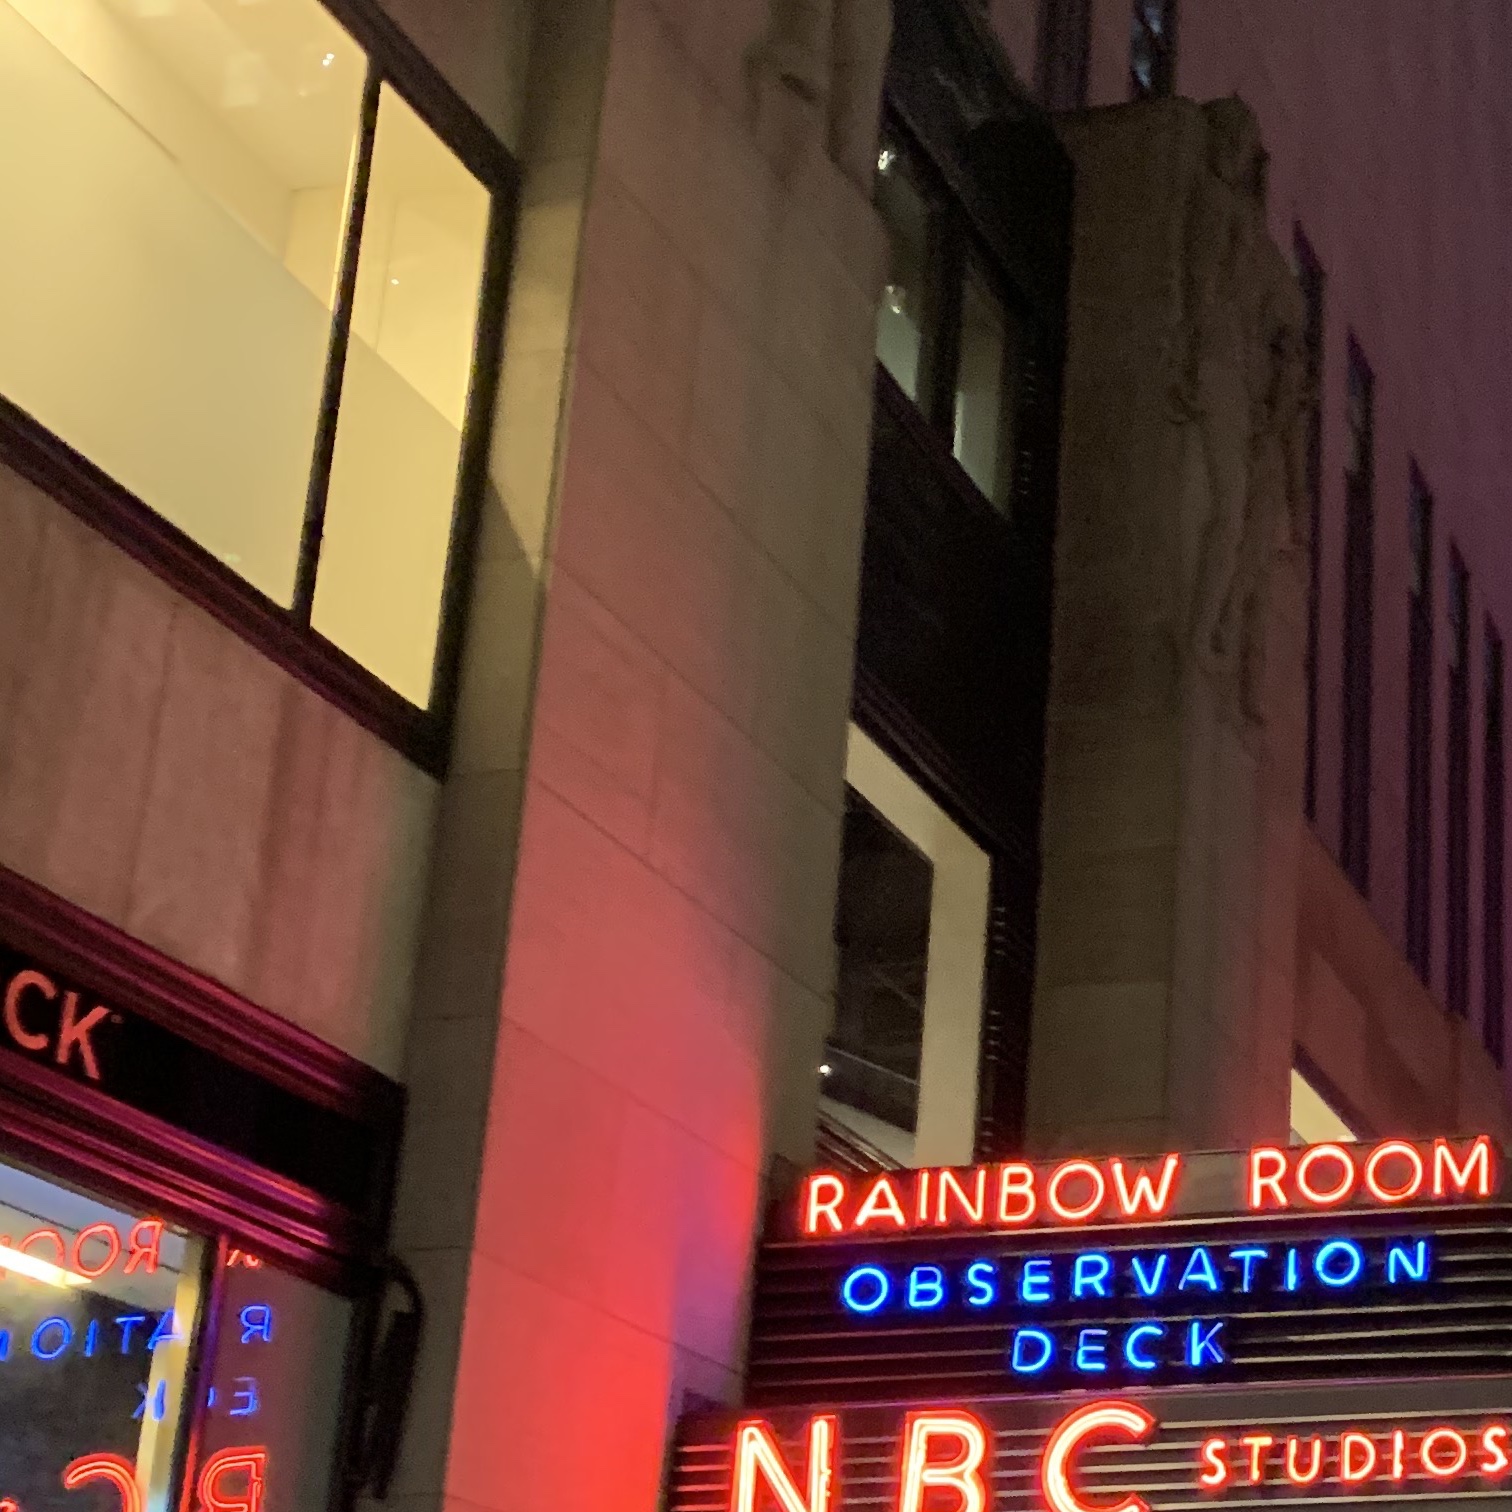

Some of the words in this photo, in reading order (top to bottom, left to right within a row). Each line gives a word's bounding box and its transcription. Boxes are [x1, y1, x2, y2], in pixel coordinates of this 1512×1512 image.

[803, 1153, 1178, 1233] RAINBOW
[1248, 1134, 1492, 1209] ROOM
[842, 1238, 1428, 1313] OBSERVATION
[1010, 1320, 1226, 1373] DECK
[1199, 1424, 1511, 1487] STUDIOS
